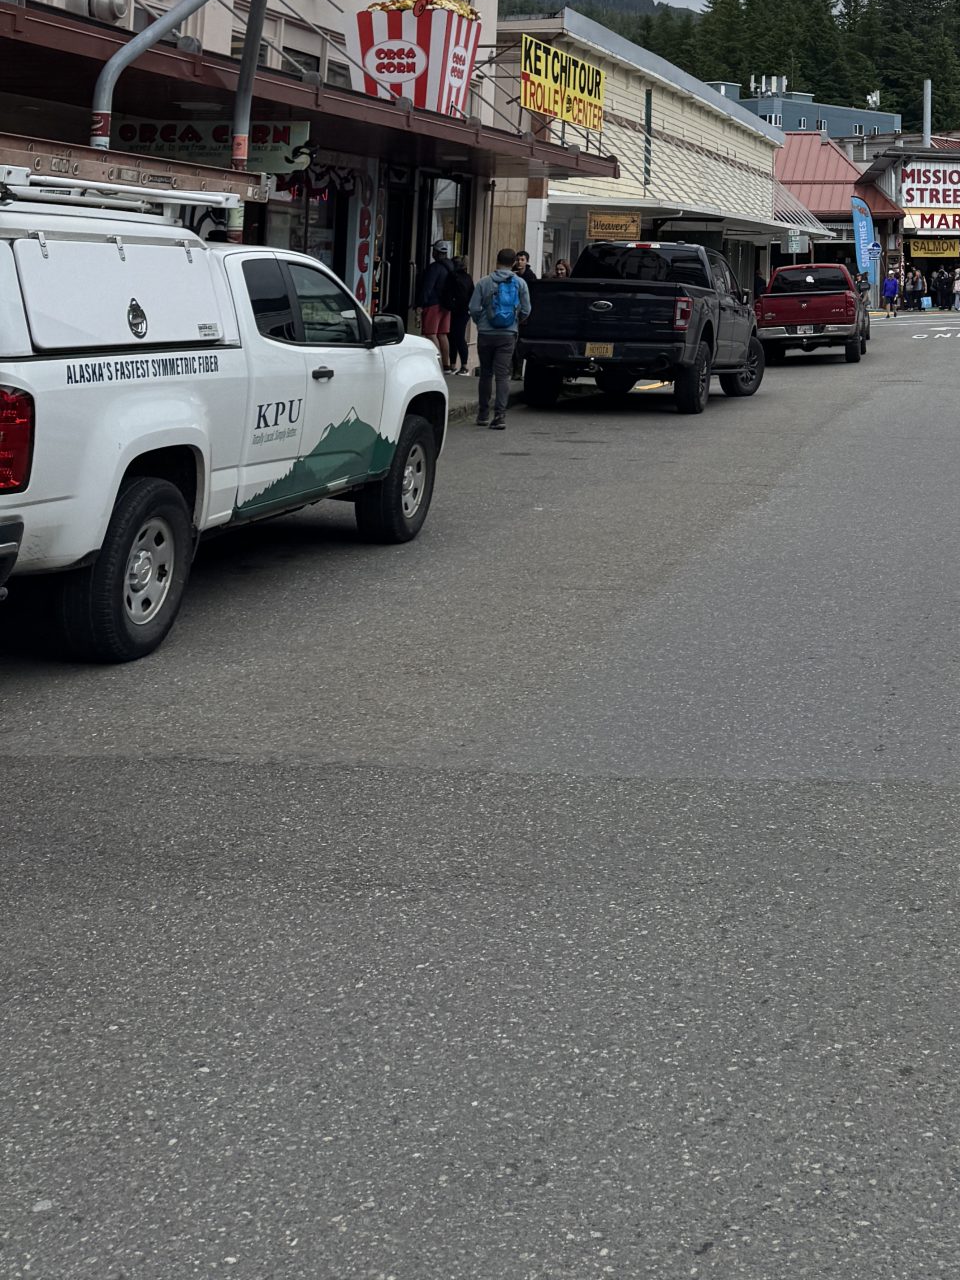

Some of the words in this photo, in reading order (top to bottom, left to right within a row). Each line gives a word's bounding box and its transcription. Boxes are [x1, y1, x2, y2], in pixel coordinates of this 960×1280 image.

[375, 47, 417, 60] ORCA
[452, 52, 466, 66] ORCA
[375, 61, 416, 73] CORN
[450, 66, 465, 80] CORN
[523, 36, 602, 100] KETCHITOUR
[521, 71, 567, 118] TROLLEY
[571, 96, 603, 131] CENTER
[119, 123, 203, 144] ORCA
[212, 124, 291, 145] CRN
[859, 220, 870, 268] SMOOTHIES
[912, 240, 956, 252] SALMON
[66, 361, 113, 385] ALASKA'S
[114, 359, 150, 381] FASTEST
[151, 357, 197, 378] SYMMETRIC
[198, 355, 219, 374] FIBER
[254, 398, 303, 430] KPU
